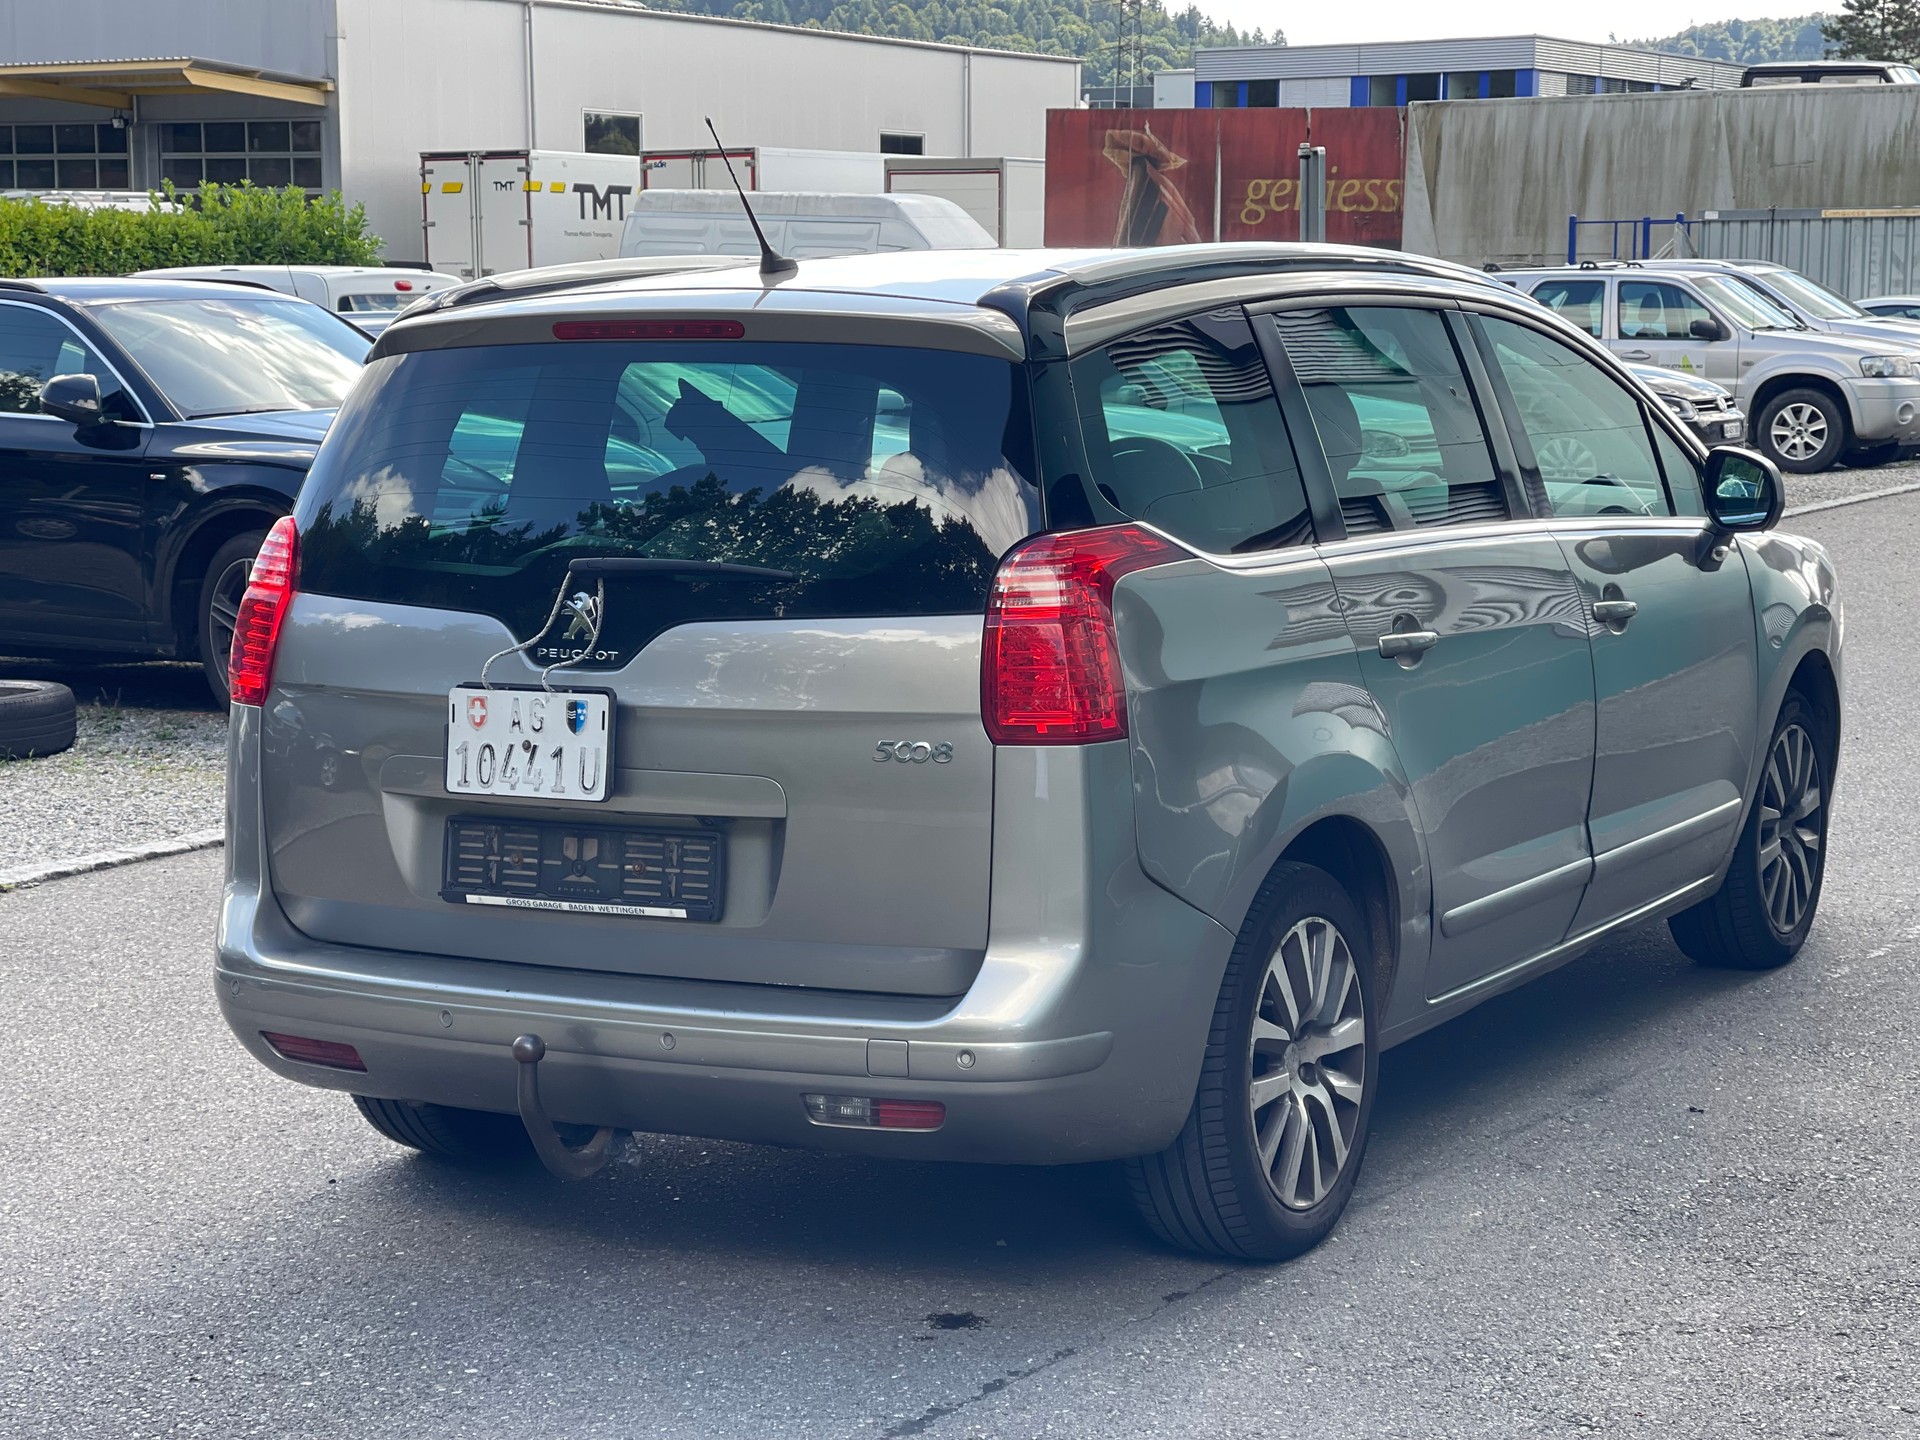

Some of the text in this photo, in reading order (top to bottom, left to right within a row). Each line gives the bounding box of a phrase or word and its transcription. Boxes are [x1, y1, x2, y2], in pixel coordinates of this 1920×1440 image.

[493, 181, 515, 191] TMT
[1240, 165, 1401, 225] geiess
[572, 183, 632, 220] TMT
[537, 647, 619, 661] PEUGEOT
[509, 697, 546, 734] AG
[872, 740, 953, 764] 5008
[455, 740, 601, 795] 10441 U
[505, 898, 646, 915] GROSS GARAGE BADEN WETTINGEN
